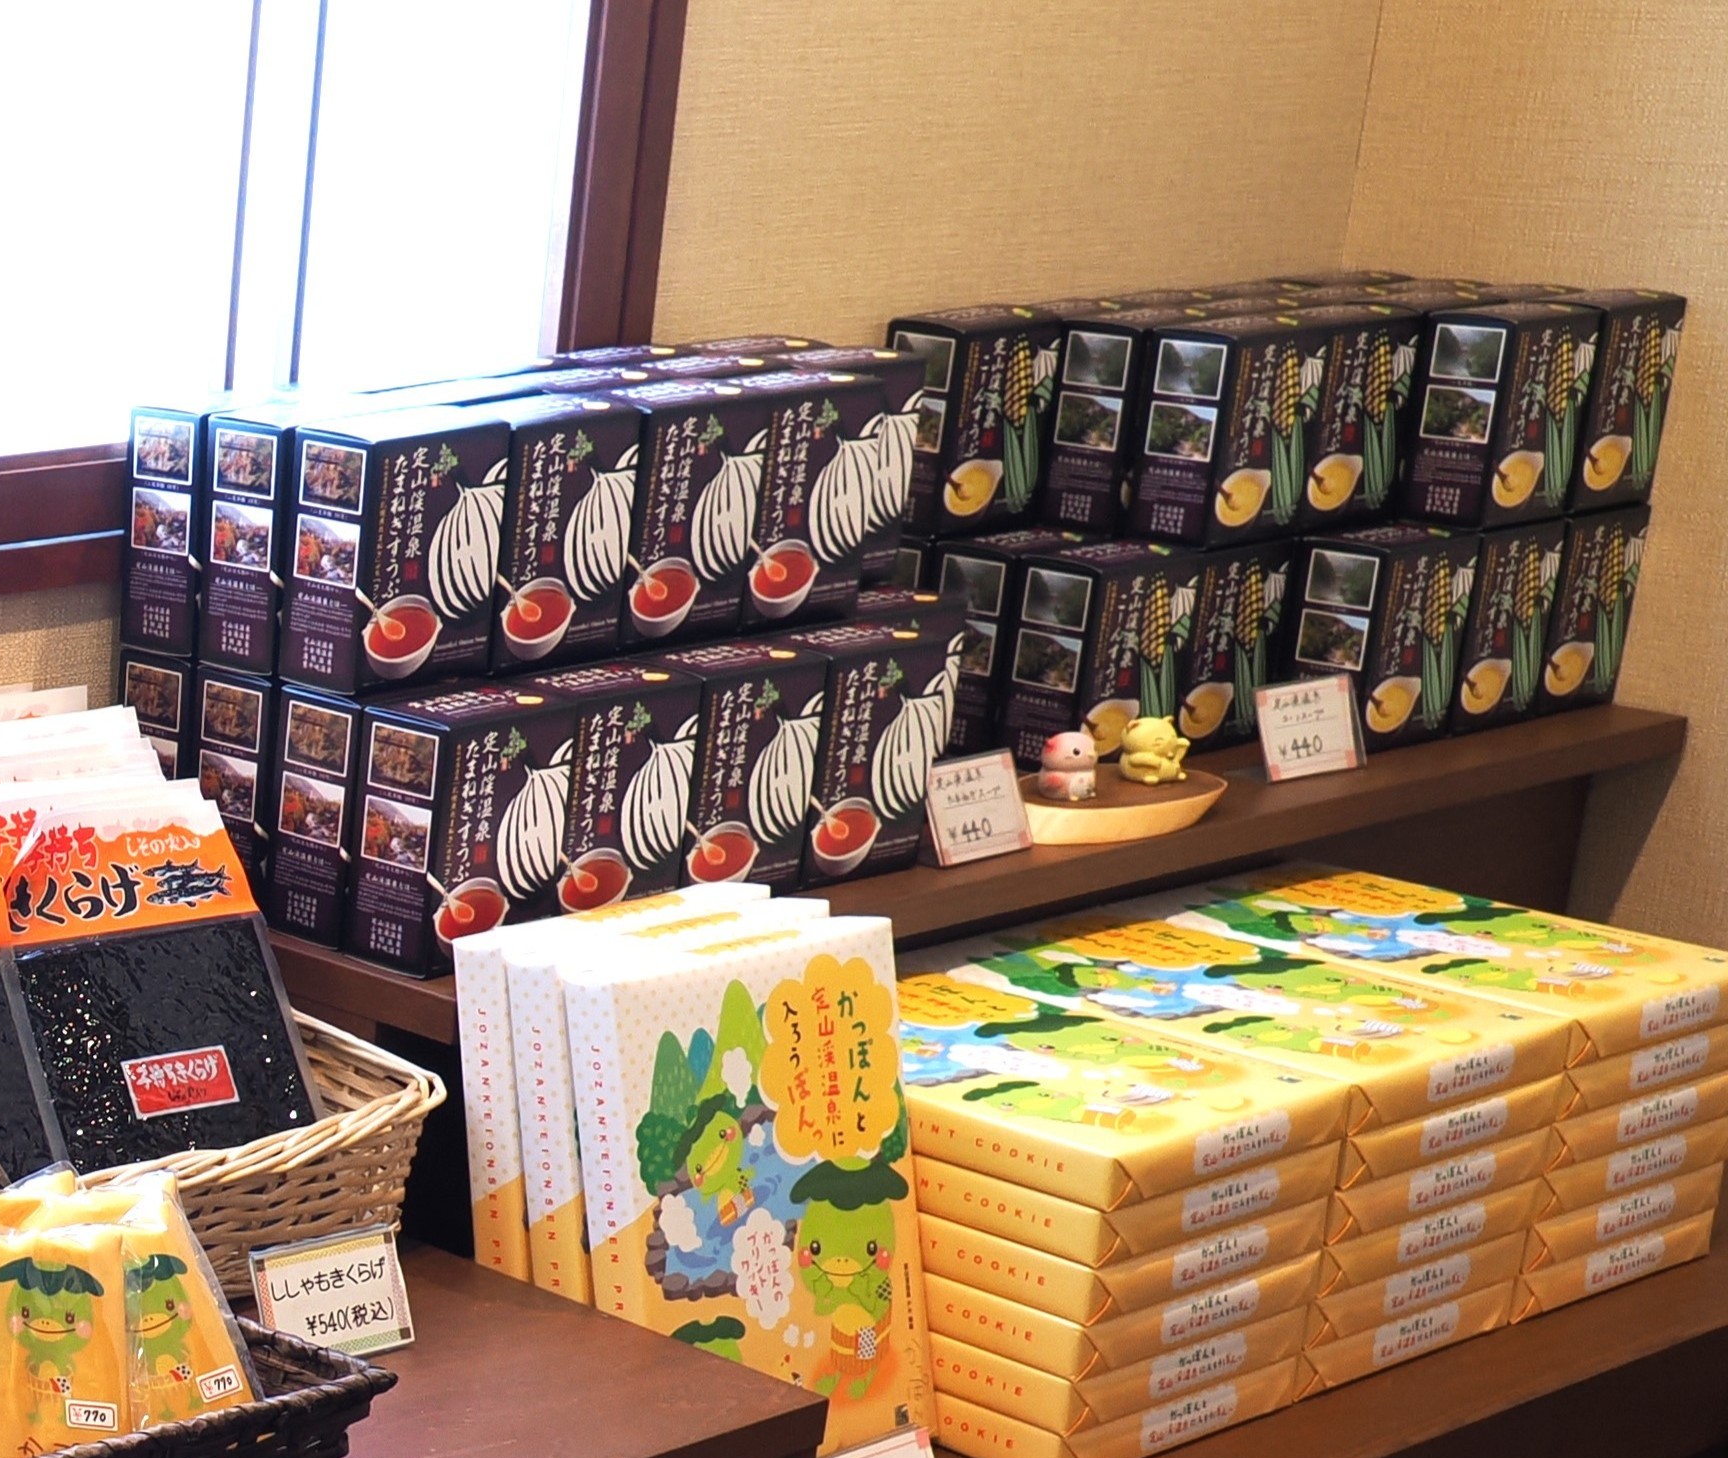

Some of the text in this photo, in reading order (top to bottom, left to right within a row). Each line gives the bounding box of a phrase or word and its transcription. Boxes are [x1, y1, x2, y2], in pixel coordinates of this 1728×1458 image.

[405, 446, 432, 559] 定山渓温泉
[542, 432, 567, 542] 定山渓温泉
[648, 423, 681, 561] たまねぎすうぷ
[671, 416, 699, 523] 定山渓温泉
[767, 408, 795, 544] たまねぎすうぷ
[789, 401, 815, 506] 定山渓温泉
[382, 453, 409, 599] たまねぎすうぷ
[520, 439, 549, 582] たまねぎすうぷ
[598, 705, 625, 813] 定山渓温泉
[705, 690, 735, 826] たまねぎすうぷ
[728, 682, 755, 788] 定山渓温泉
[830, 669, 860, 802] たまねぎすうぷ
[852, 661, 879, 764] 定山渓温泉
[1278, 734, 1323, 759] ¥440
[452, 739, 480, 883] たまねぎすうぷ
[474, 731, 501, 843] 定山渓温泉
[576, 713, 604, 853] たまねぎすうぷ
[947, 817, 992, 842] ¥440
[7, 862, 142, 935] きくらげ
[136, 1054, 219, 1092] 子持ちきくらげ
[782, 1001, 823, 1142] 入ろうぽんっ
[811, 986, 845, 1148] 定山渓温泉に
[838, 990, 874, 1134] かっぽんと
[975, 1137, 1065, 1173] COOKIE
[747, 1232, 769, 1289] プリント
[963, 1192, 1052, 1228] COOKIE
[271, 1256, 386, 1302] ししゃもきくらげ
[306, 1296, 395, 1337] ¥540(税込)
[741, 1259, 763, 1312] クッキー
[763, 1231, 784, 1303] かっぽんの
[957, 1249, 1046, 1287] COOKIE
[945, 1303, 1033, 1341] COOKIE
[72, 1408, 107, 1424] ¥770
[204, 1375, 234, 1396] ¥770
[935, 1358, 1023, 1397] COOKIE
[944, 1416, 1014, 1449] OOKIE
